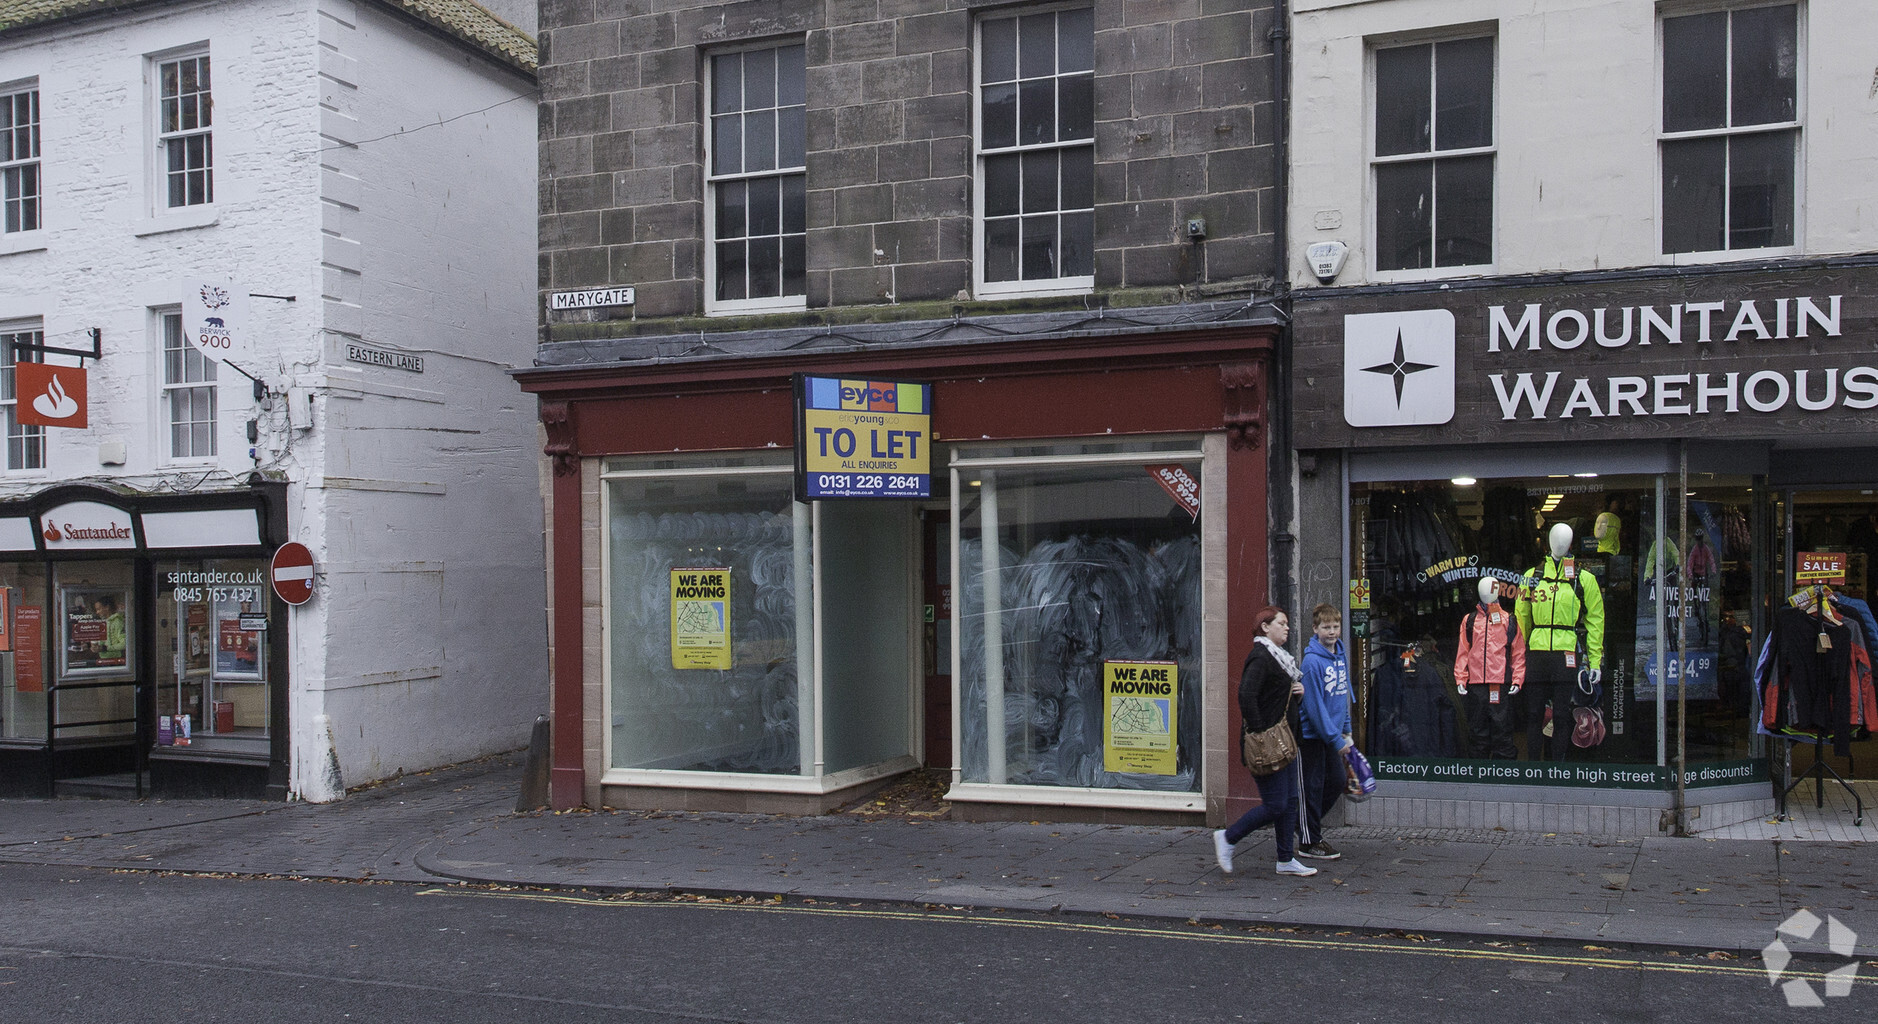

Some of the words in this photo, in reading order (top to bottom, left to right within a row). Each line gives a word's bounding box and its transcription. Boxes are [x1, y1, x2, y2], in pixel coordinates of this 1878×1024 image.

[557, 289, 629, 308] MARYGATE
[200, 327, 231, 336] BERWICK
[1487, 295, 1843, 353] MOUNTAIN
[200, 334, 231, 349] 900
[349, 347, 393, 366] EASTERN
[396, 355, 421, 370] LANE
[840, 386, 897, 405] eyco
[814, 427, 857, 458] TO
[870, 429, 922, 460] LET
[841, 460, 856, 469] ALL
[858, 461, 898, 470] ENQUIRIES
[819, 475, 851, 489] 0131
[856, 476, 884, 489] 226
[888, 477, 920, 489] 2641
[1160, 468, 1178, 485] 697
[1176, 483, 1199, 506] 9929
[1174, 468, 1198, 493] 0203
[63, 521, 131, 540] Santander
[1425, 559, 1454, 578] WARM
[1454, 556, 1468, 568] UP
[167, 568, 263, 584] santander.co.uk
[678, 575, 697, 586] WE
[700, 575, 723, 586] ARE
[1442, 567, 1479, 584] WINTER
[1480, 567, 1540, 588] ACCESSORIES
[173, 587, 202, 602] 0845
[205, 587, 227, 602] 765
[230, 587, 259, 602] 4321
[676, 586, 726, 598] MOVING
[1490, 580, 1527, 602] FROM
[1649, 586, 1679, 601] AIVE
[1683, 587, 1711, 602] SO-VIZ
[1667, 605, 1693, 618] JACET
[1113, 667, 1137, 681] WE
[1140, 668, 1168, 682] ARE
[1110, 680, 1172, 695] MOVING
[1378, 761, 1429, 776] Factory
[1433, 763, 1473, 776] outlet
[1478, 766, 1520, 778] prices
[1525, 768, 1543, 778] on
[1548, 767, 1571, 779] the
[1576, 768, 1607, 783] high
[1612, 770, 1656, 783] street
[1671, 770, 1697, 785] hge
[1700, 764, 1754, 780] discounts!
